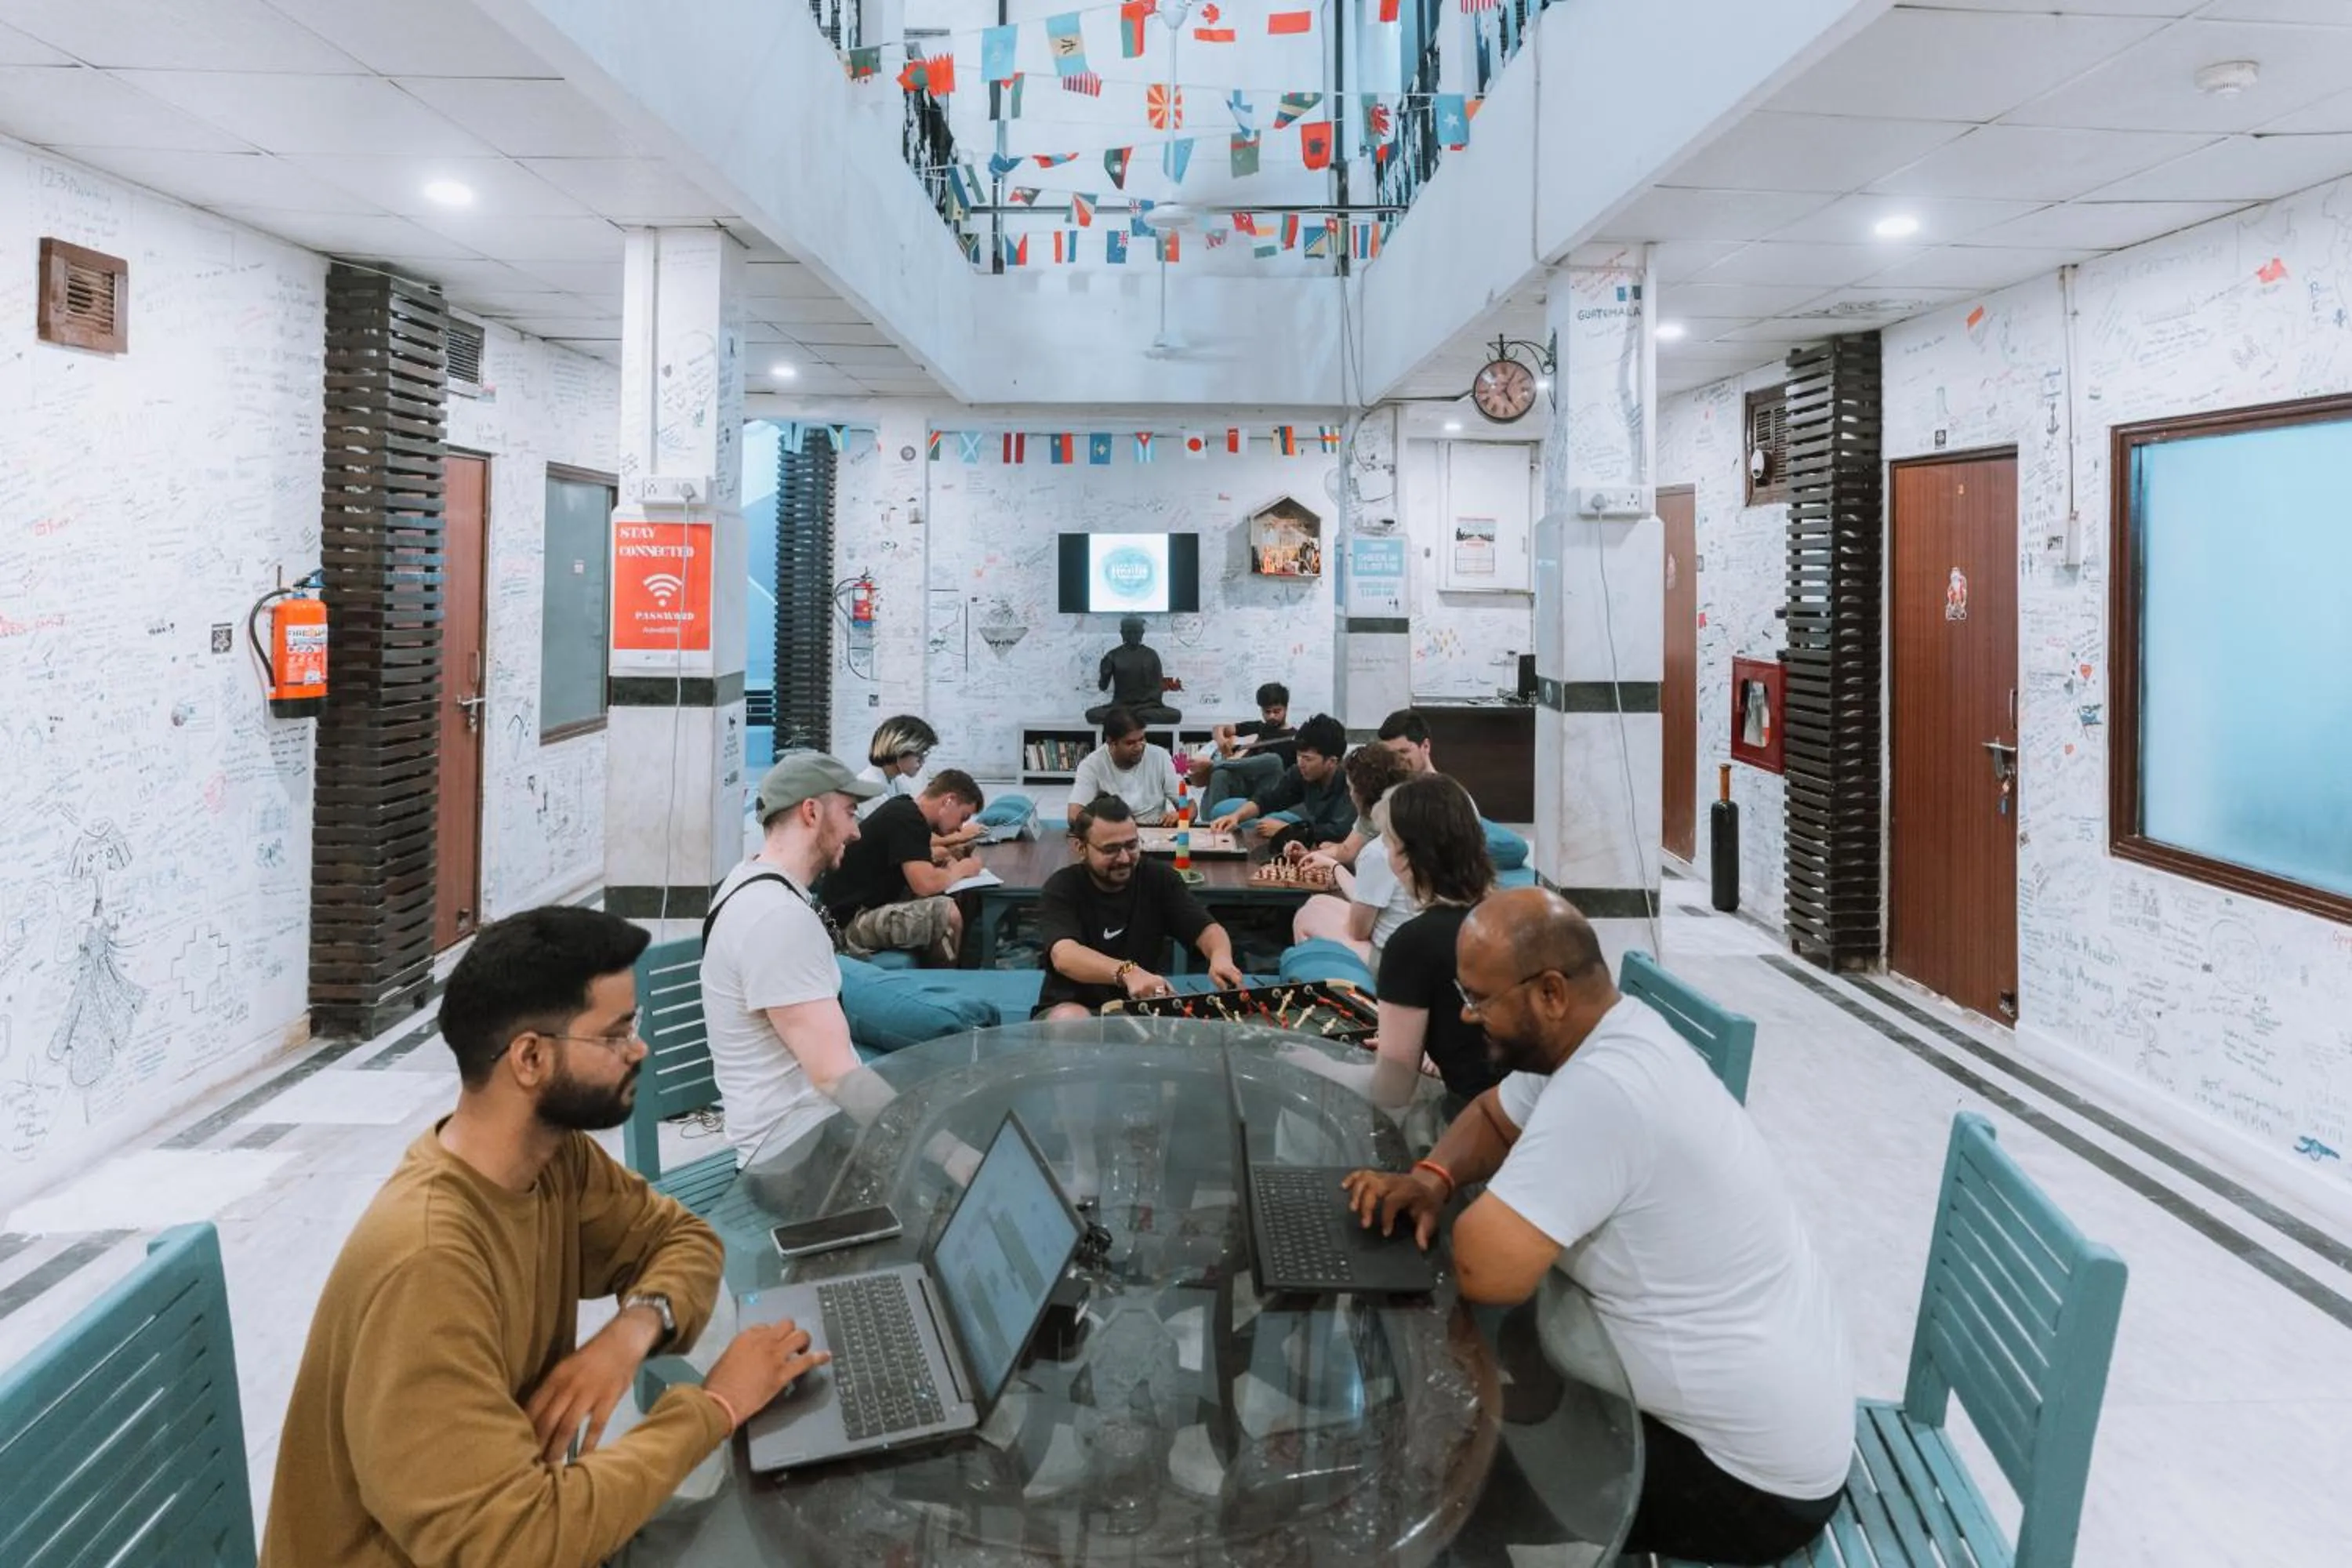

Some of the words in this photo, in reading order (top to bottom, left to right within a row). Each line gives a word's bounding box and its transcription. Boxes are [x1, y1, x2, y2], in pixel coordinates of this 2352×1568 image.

[1577, 307, 1641, 321] GUATEMALA
[619, 527, 655, 539] STAY
[619, 545, 695, 557] CONNECTED
[635, 612, 695, 620] PASSWORD
